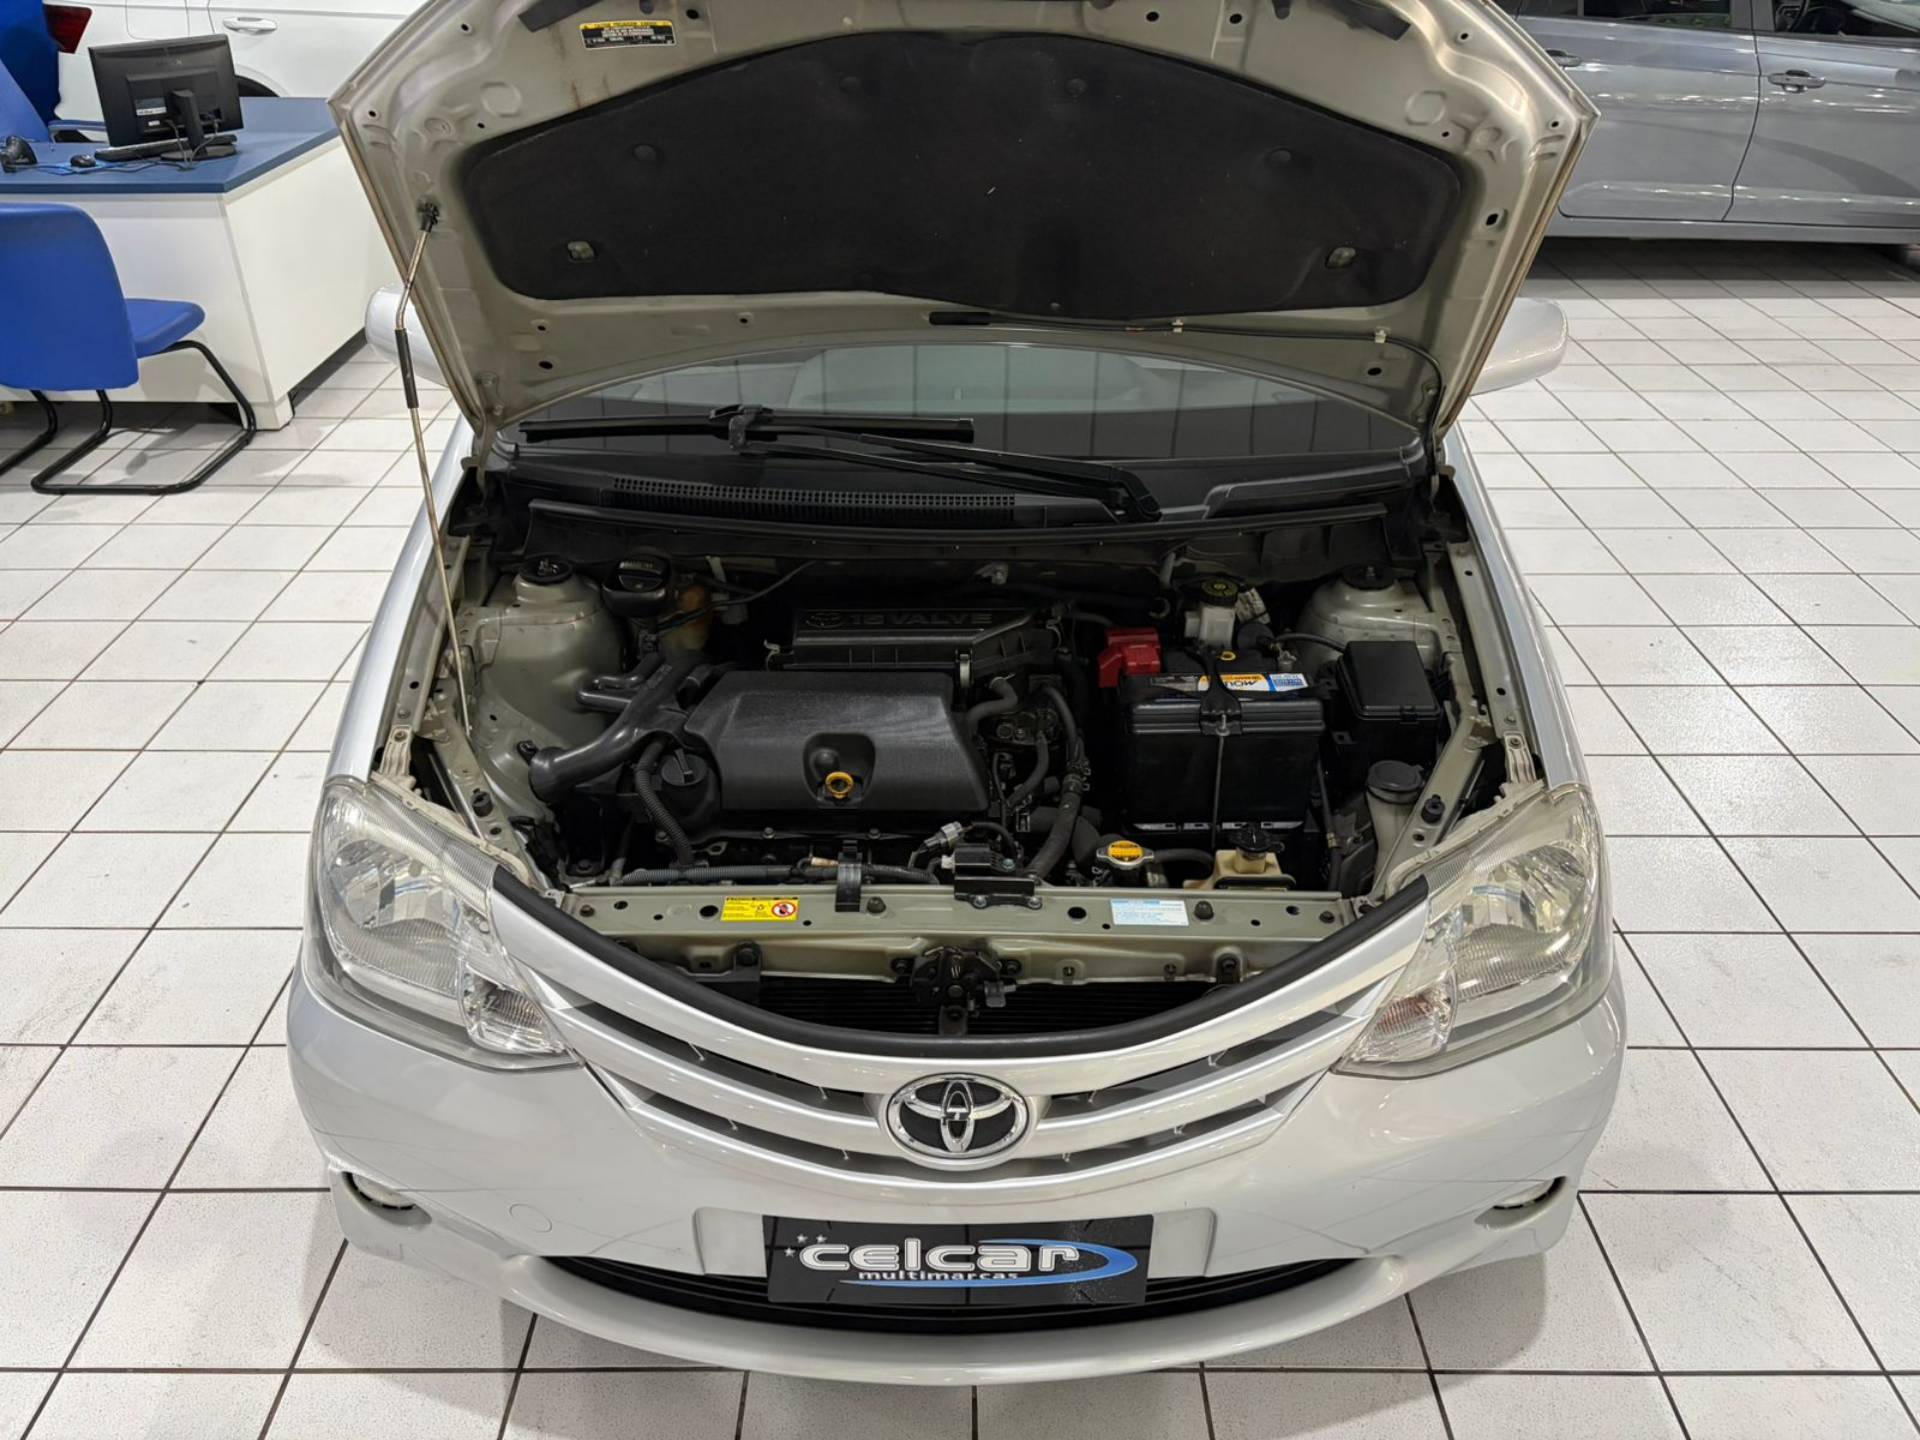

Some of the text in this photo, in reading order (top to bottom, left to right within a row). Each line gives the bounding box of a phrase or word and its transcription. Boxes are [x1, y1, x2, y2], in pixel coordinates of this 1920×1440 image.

[891, 613, 993, 625] VALVE
[799, 1238, 1080, 1271] celcar
[858, 1270, 1018, 1280] multimarcas
